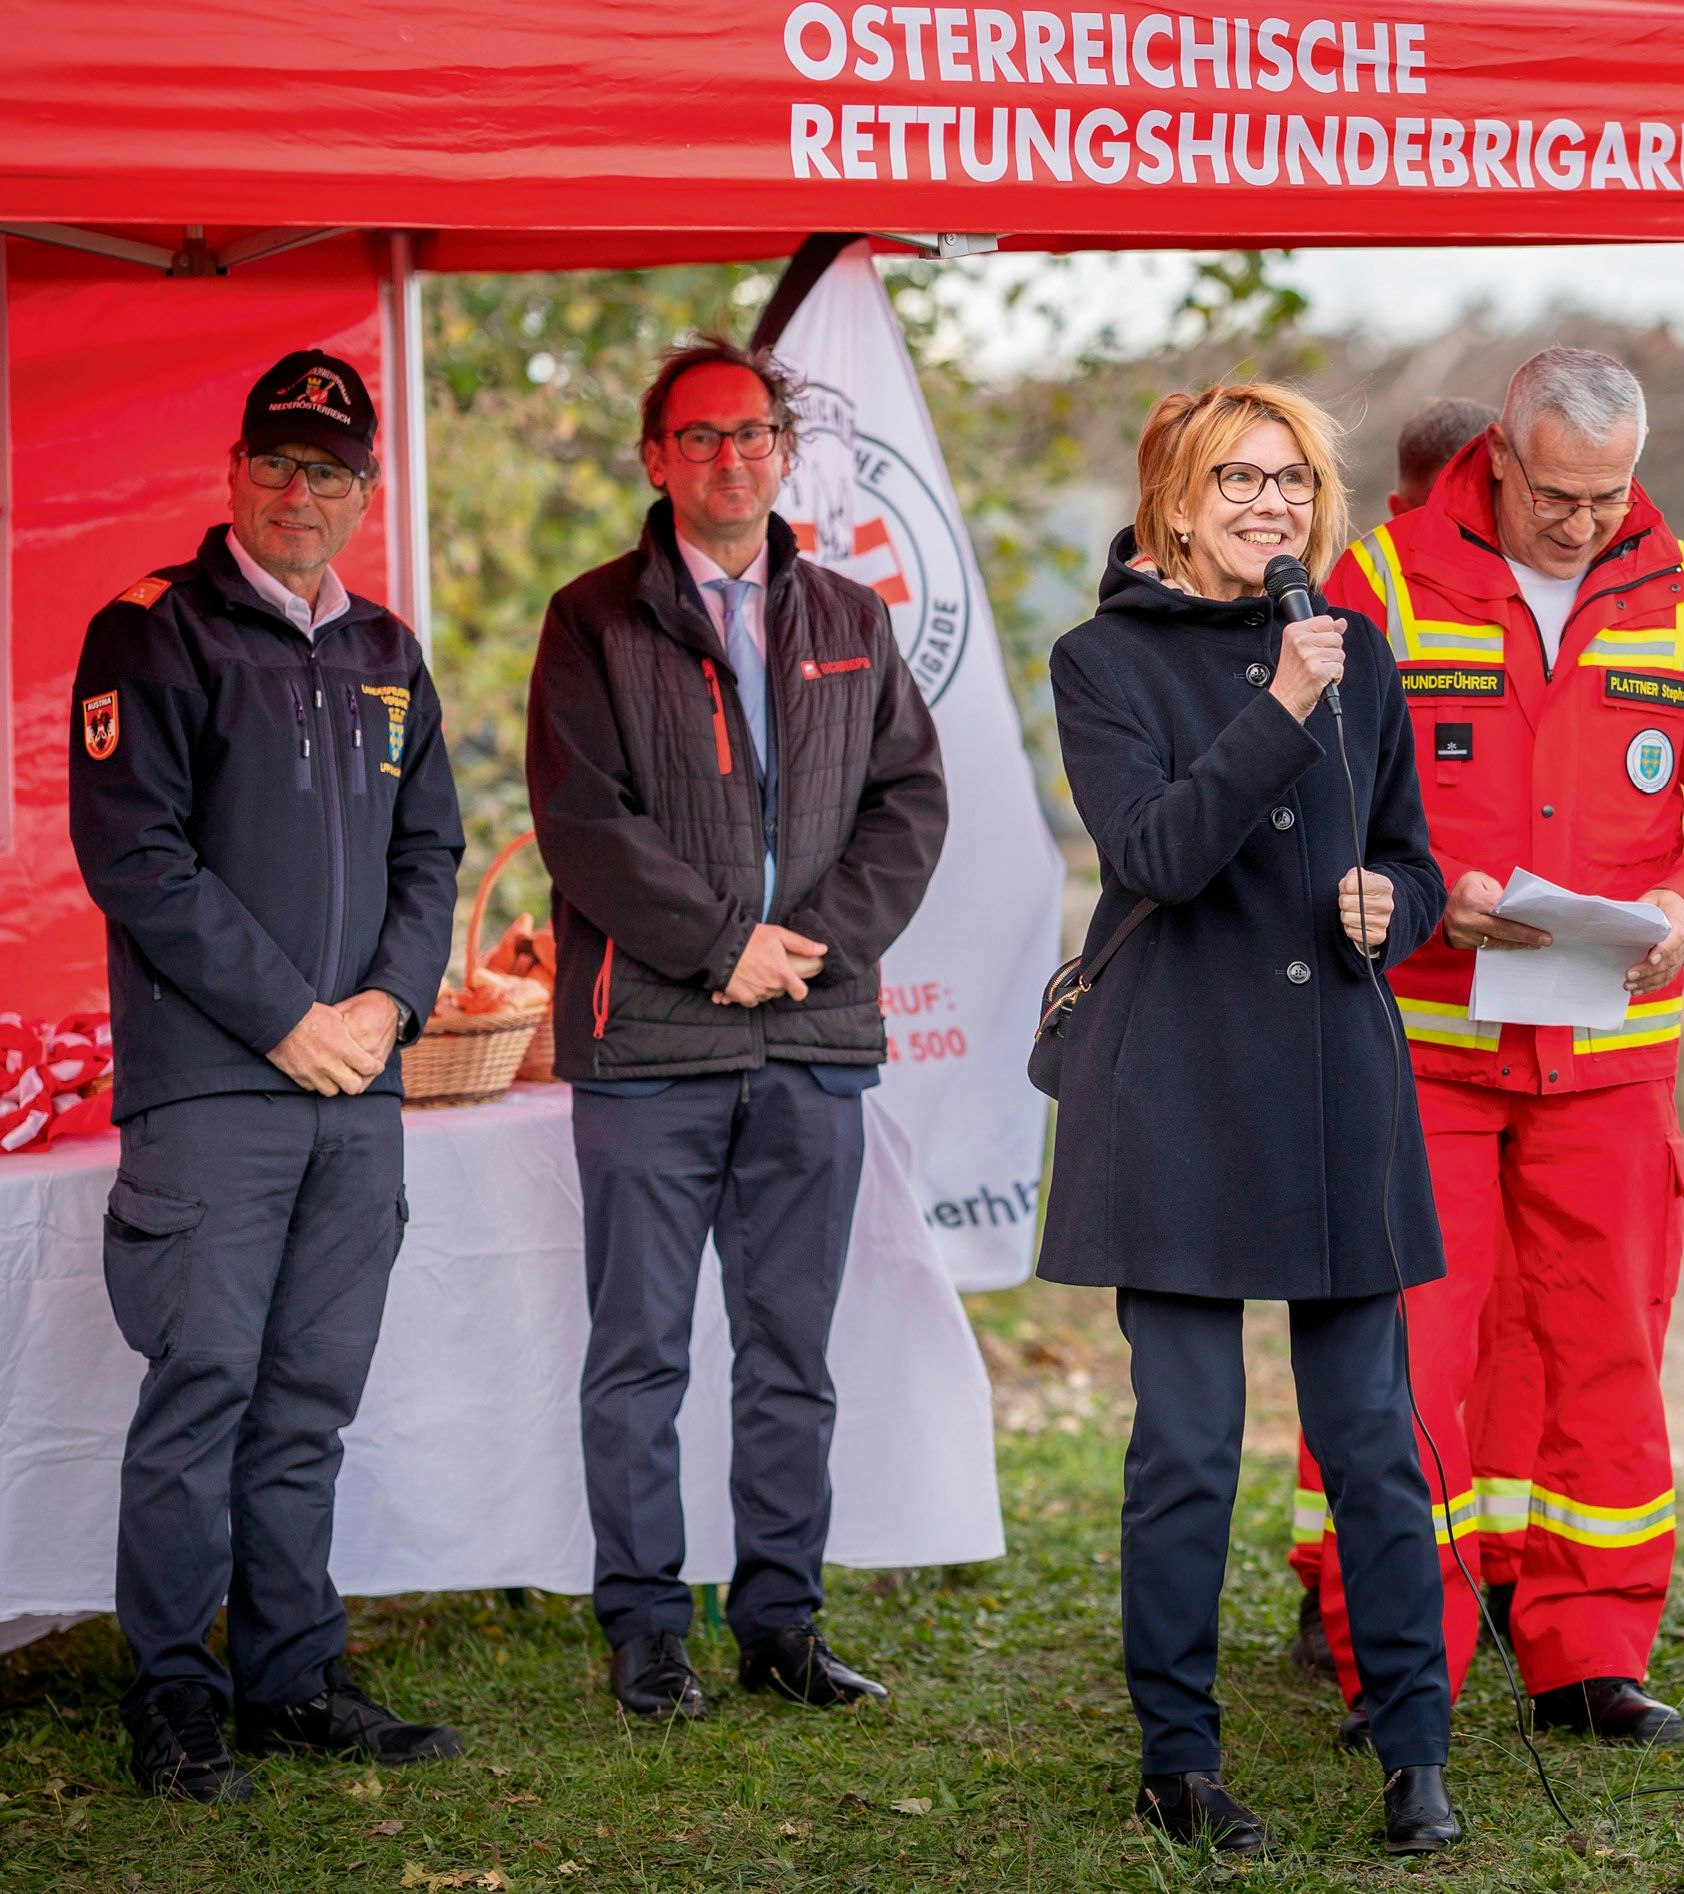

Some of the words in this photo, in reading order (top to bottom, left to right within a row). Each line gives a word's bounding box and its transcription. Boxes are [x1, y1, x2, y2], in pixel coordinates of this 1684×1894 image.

[1401, 671, 1498, 690] HUNDEFÜHRER
[1610, 676, 1659, 697] PLATTNER
[87, 696, 112, 711] AUSTRIA
